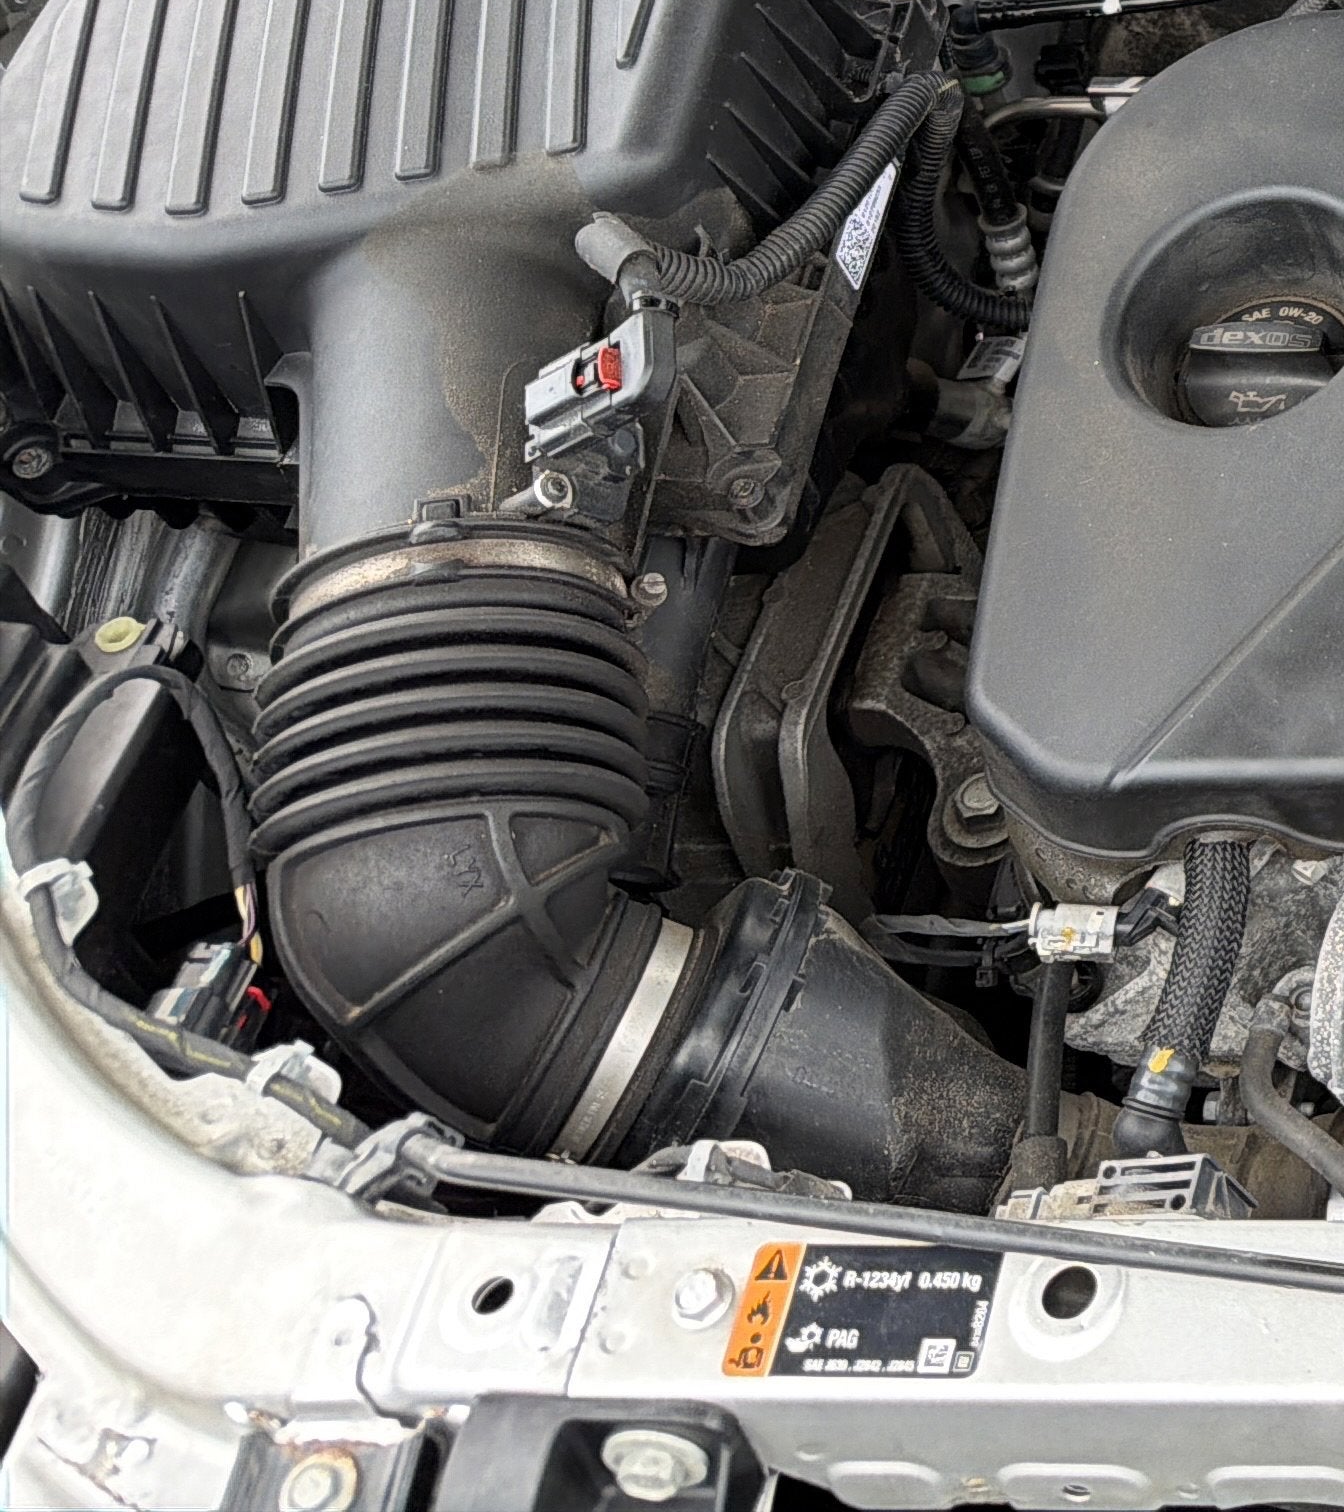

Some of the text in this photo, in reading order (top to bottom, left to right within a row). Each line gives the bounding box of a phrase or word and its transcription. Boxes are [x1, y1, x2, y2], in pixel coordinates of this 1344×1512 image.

[1241, 306, 1324, 326] SAE 0W-20
[1199, 327, 1313, 347] dexos
[843, 1270, 983, 1293] R-1234yf 0.450 kg
[825, 1328, 860, 1349] PAG
